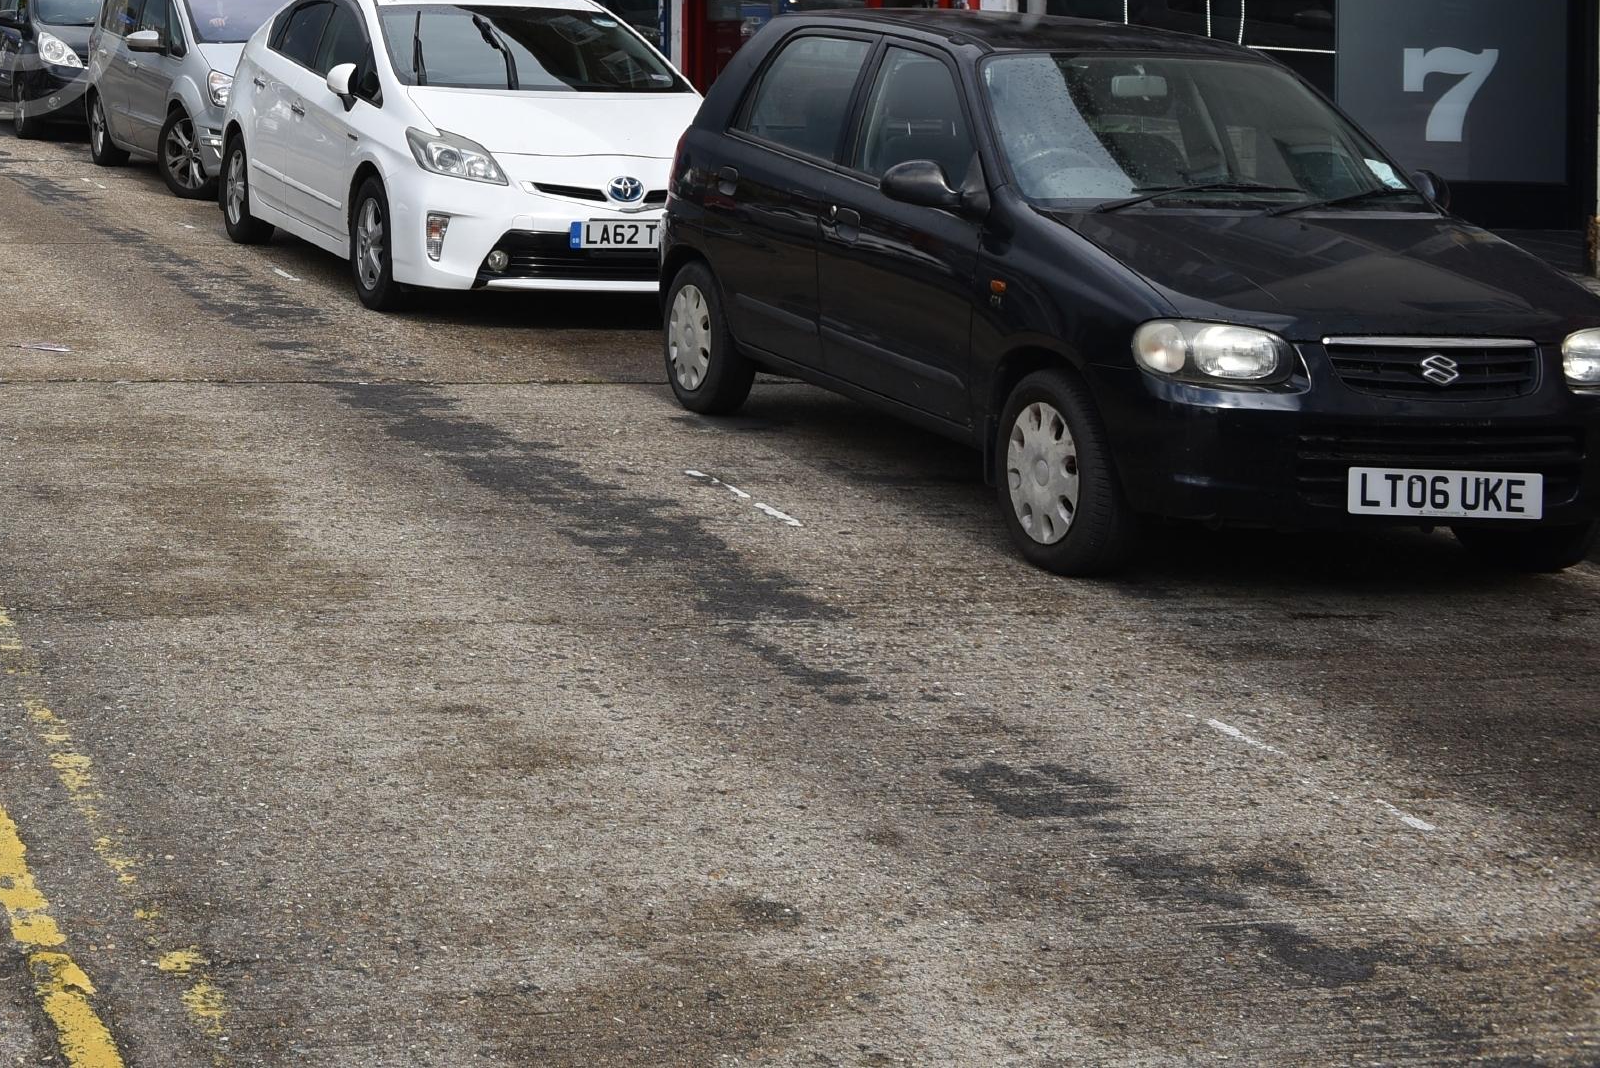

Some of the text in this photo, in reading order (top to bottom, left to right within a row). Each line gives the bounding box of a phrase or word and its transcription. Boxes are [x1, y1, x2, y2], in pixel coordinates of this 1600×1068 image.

[1403, 46, 1499, 142] 7
[585, 224, 639, 244] LA62
[1360, 473, 1525, 513] LT06 UKE
